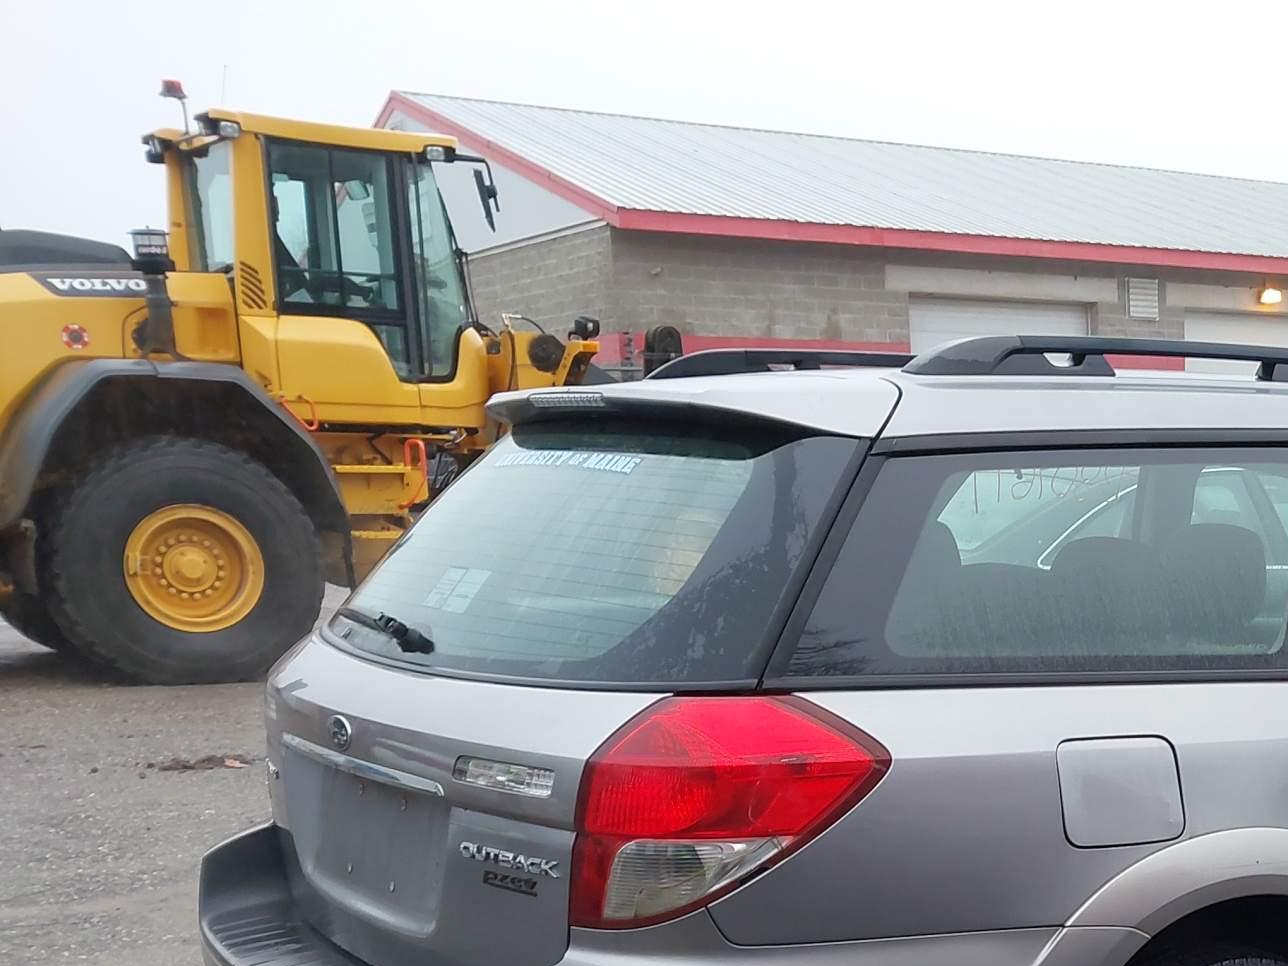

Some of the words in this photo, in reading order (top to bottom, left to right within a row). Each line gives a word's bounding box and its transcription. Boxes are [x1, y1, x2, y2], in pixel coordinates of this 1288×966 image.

[46, 278, 147, 291] VOLVO
[583, 452, 641, 474] MAINE
[460, 841, 561, 878] OUTBACK
